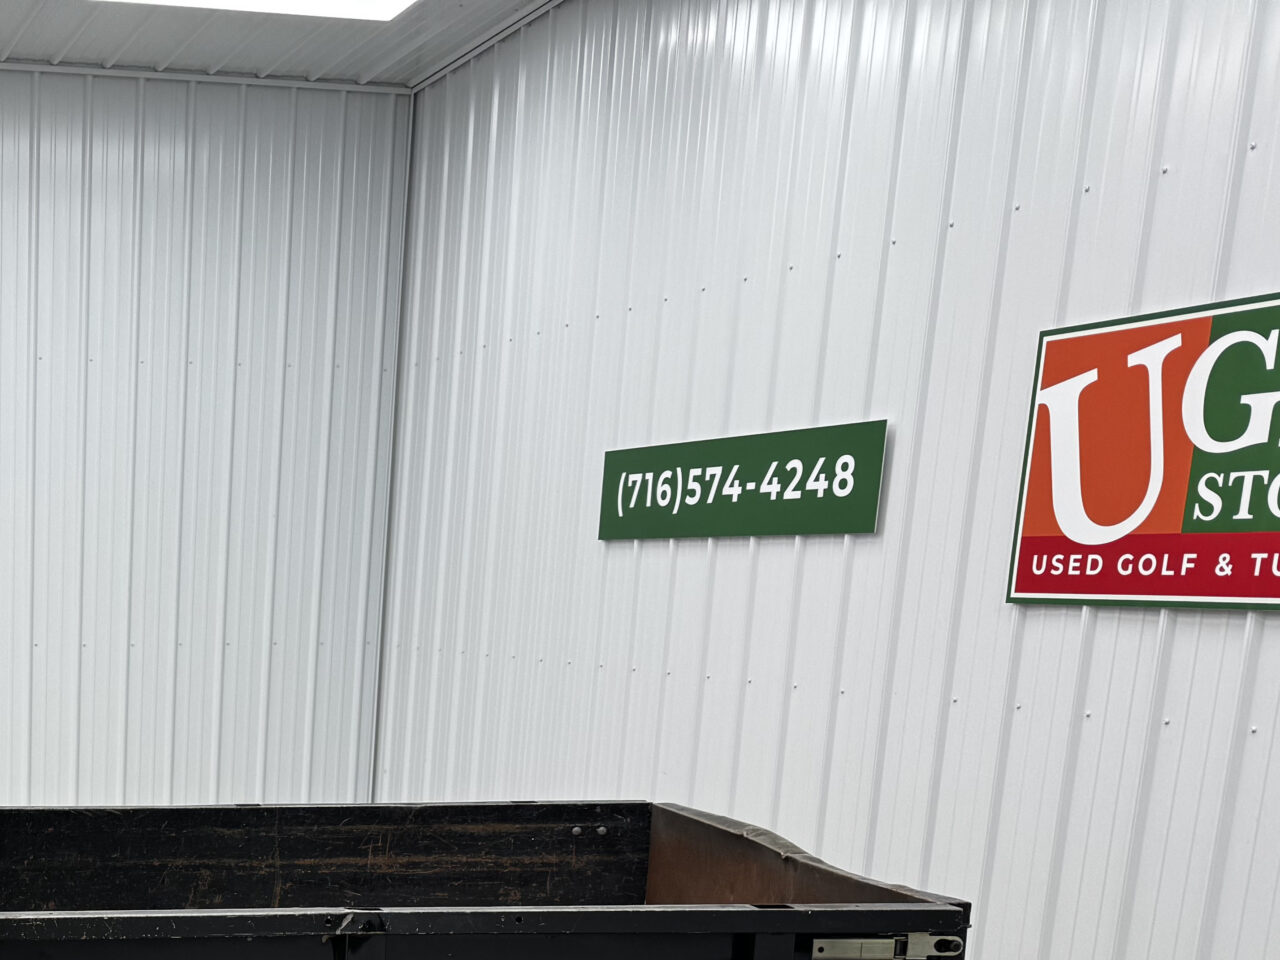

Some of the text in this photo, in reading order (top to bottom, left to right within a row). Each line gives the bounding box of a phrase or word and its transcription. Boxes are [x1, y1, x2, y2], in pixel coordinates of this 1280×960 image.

[1038, 328, 1280, 546] UG
[617, 454, 856, 518] (716)574-4248
[1030, 553, 1104, 576] USED
[1116, 552, 1198, 576] GOLF
[1214, 552, 1233, 577] &
